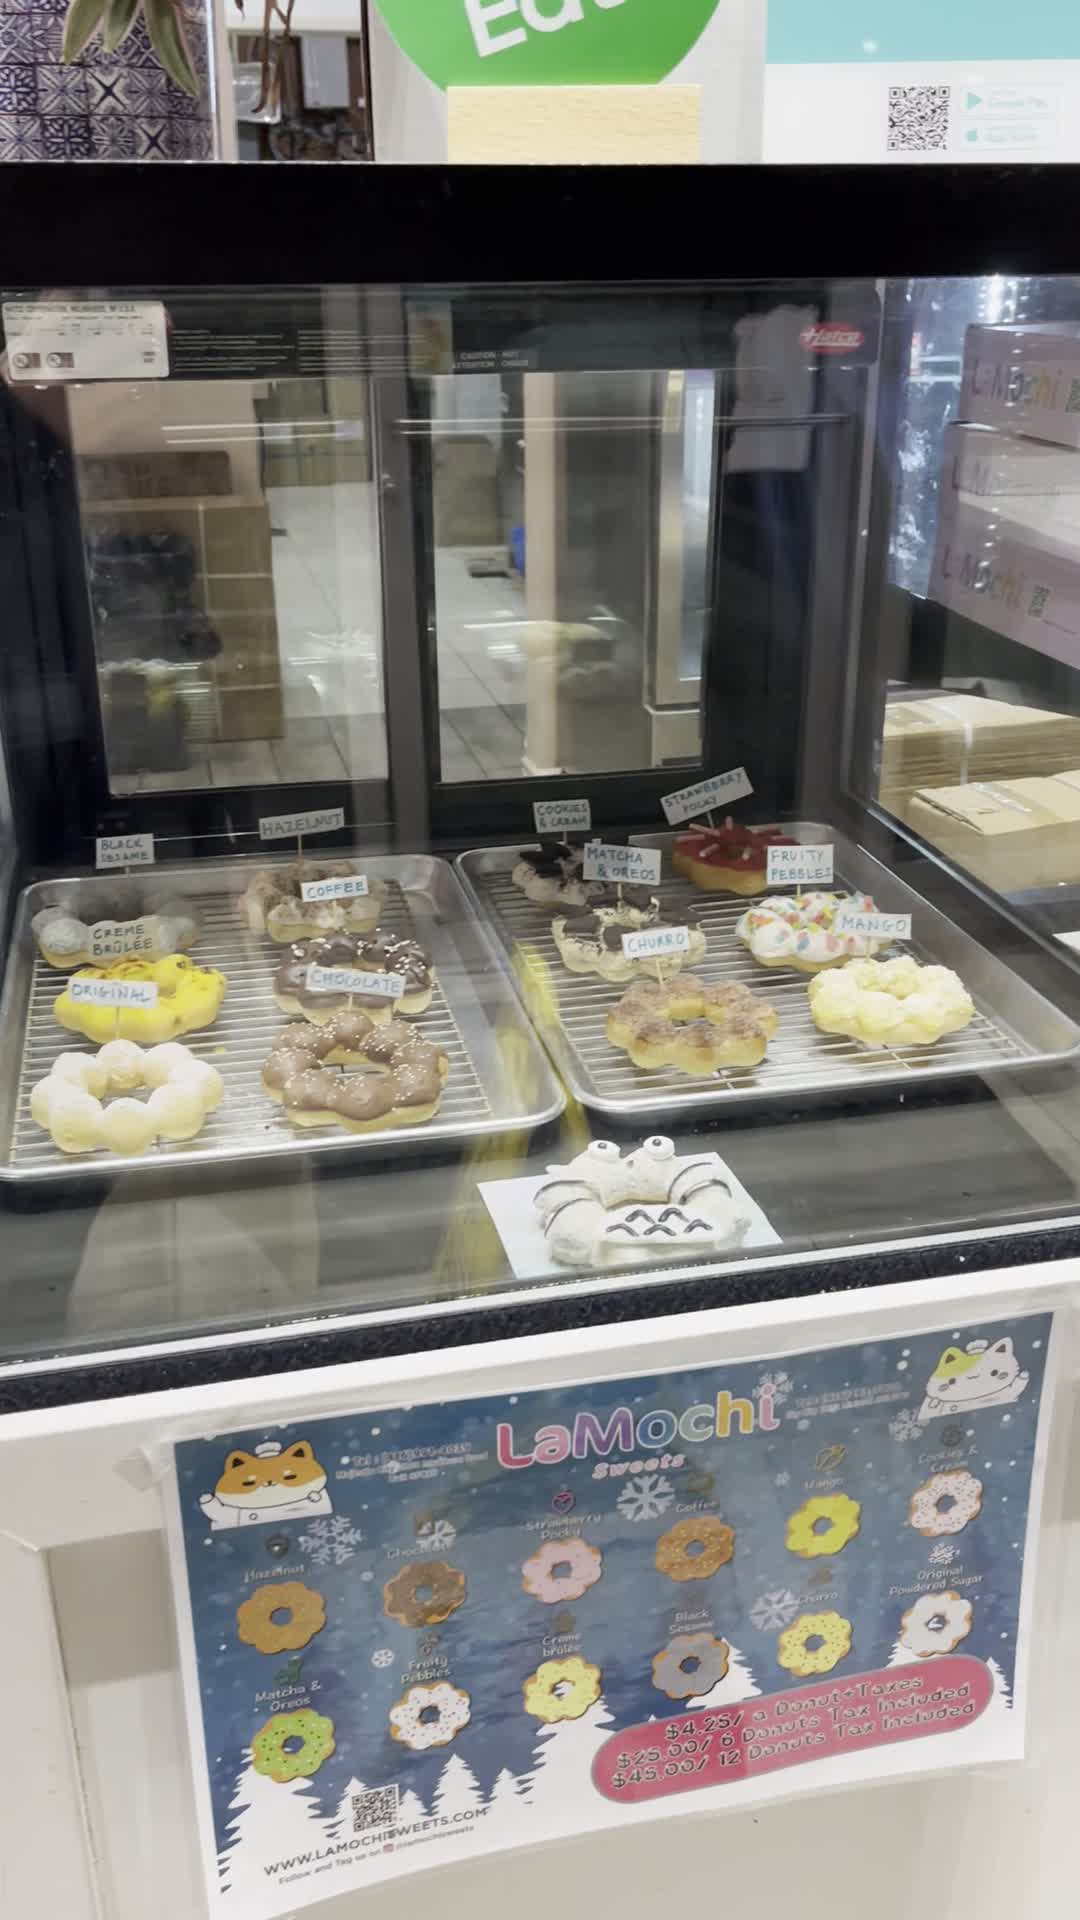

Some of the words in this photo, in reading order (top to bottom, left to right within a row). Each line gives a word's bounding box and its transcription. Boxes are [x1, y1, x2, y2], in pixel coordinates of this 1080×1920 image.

[537, 803, 588, 816] COOKIES
[261, 813, 342, 836] HAZELNUT
[101, 838, 144, 850] BLACK
[587, 847, 643, 864] MATCHA
[771, 849, 824, 862] FRUITY
[598, 864, 608, 878] &
[612, 866, 656, 880] OREOS
[771, 867, 832, 881] PEBBLES
[306, 881, 365, 899] COFFEE
[842, 914, 907, 931] MANGO
[93, 924, 145, 939] CREME
[628, 932, 686, 953] CHURRO
[312, 969, 401, 992] CHOCOLATE
[72, 983, 152, 1002] ORIGINAL
[497, 1383, 781, 1470] LaMochi
[592, 1453, 687, 1480] Sweets
[917, 1565, 963, 1580] Original
[951, 1574, 985, 1588] Sugar
[675, 1609, 710, 1623] Black
[408, 1656, 449, 1671] Fruity
[255, 1685, 306, 1702] Matcha
[311, 1680, 321, 1691] &
[269, 1697, 311, 1712] Oreos
[617, 1735, 713, 1769] $25.00/
[720, 1732, 735, 1747] 6
[742, 1714, 822, 1744] Donuts
[828, 1704, 870, 1722] Tax
[877, 1681, 970, 1714] Included
[666, 1710, 745, 1740] $4.25/
[753, 1710, 767, 1722] a
[611, 1755, 709, 1789] $45.00/
[719, 1750, 741, 1766] 12
[748, 1729, 826, 1761] Donuts
[833, 1721, 875, 1738] Tax
[882, 1700, 976, 1730] Included
[264, 1807, 490, 1876] WWW.LAMOCHISWEETS.COM
[279, 1870, 311, 1885] Follow
[314, 1862, 333, 1874] and
[336, 1857, 353, 1868] Tag
[355, 1853, 367, 1862] us
[369, 1850, 382, 1859] on
